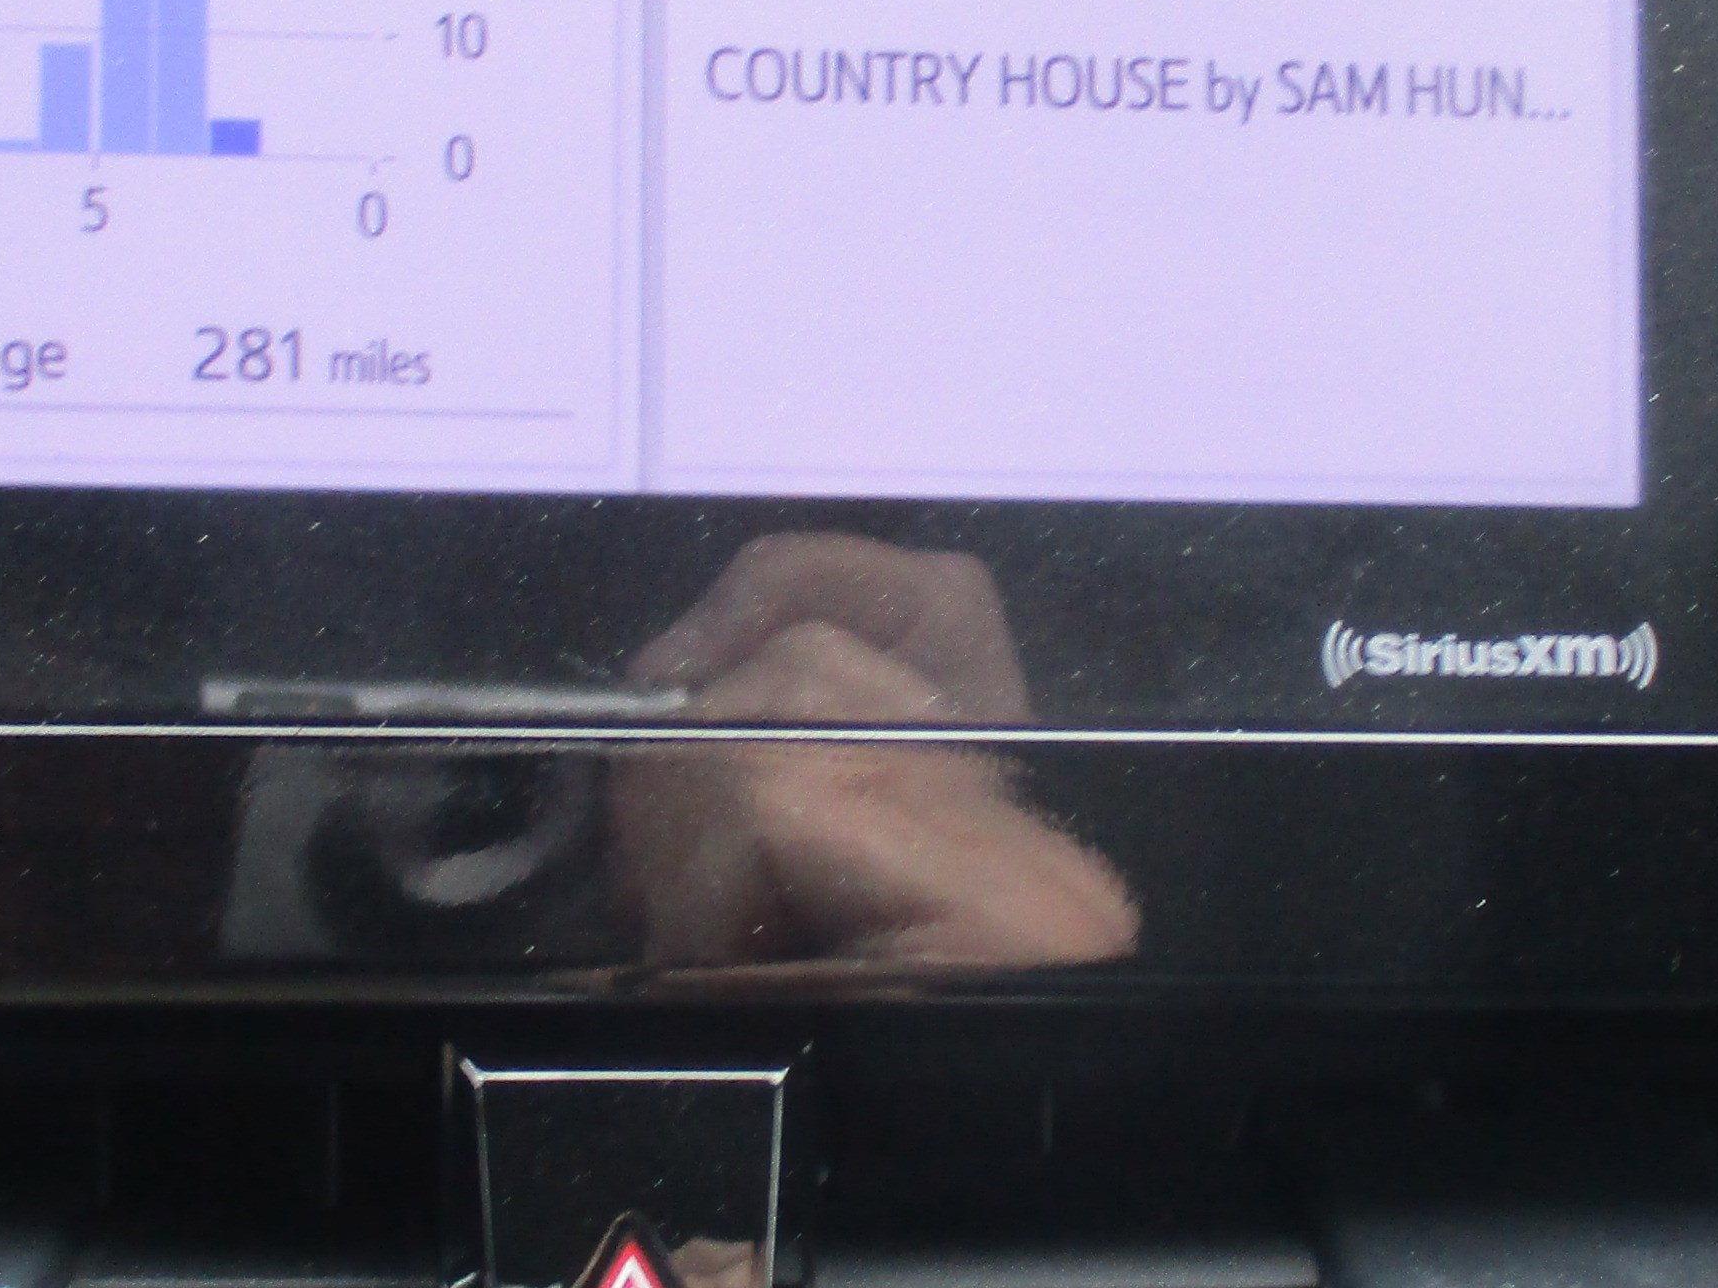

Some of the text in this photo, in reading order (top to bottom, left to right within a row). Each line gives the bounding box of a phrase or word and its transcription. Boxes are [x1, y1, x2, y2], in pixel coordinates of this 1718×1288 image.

[435, 13, 490, 61] 10
[704, 45, 983, 108] COUNTRY
[999, 53, 1191, 112] HOUSE
[1206, 59, 1260, 124] by
[1276, 60, 1390, 119] SAM
[444, 134, 475, 182] 0
[81, 185, 110, 234] 5
[356, 191, 389, 239] 0
[191, 325, 304, 383] 281
[328, 340, 434, 386] miles
